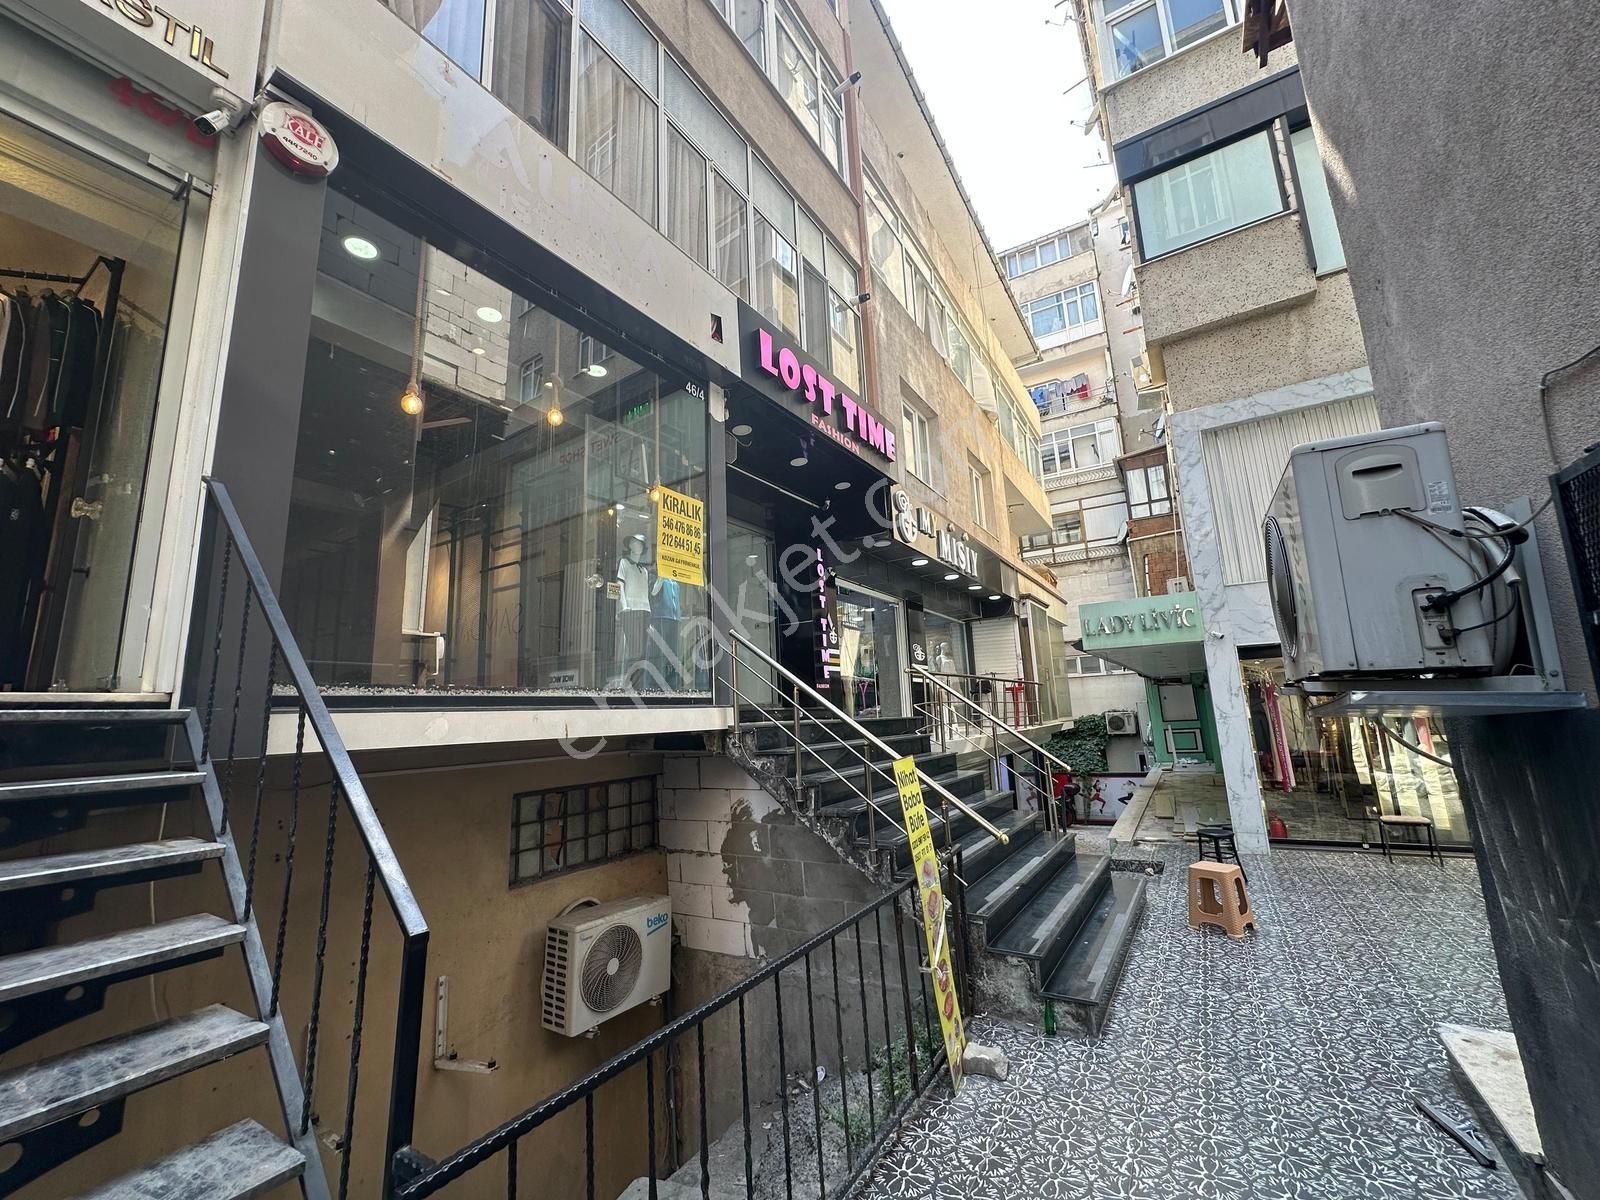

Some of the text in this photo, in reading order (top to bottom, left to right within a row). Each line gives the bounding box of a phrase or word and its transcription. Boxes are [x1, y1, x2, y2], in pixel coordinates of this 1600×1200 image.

[99, 0, 230, 80] STİL
[283, 111, 326, 150] KALE
[282, 136, 318, 161] 4447240
[685, 381, 705, 401] 46/4
[757, 327, 896, 463] LOST TIME
[811, 412, 860, 456] FASHION
[662, 515, 674, 531] 546
[674, 519, 686, 535] 476
[685, 523, 694, 537] 86
[917, 506, 938, 538] MY
[661, 531, 701, 555] 212 644 51 45
[816, 547, 830, 679] LOST TIME
[1083, 614, 1136, 637] LADY
[896, 767, 917, 789] Nihat
[902, 791, 922, 812] Baba
[908, 811, 925, 834] Büfe
[646, 912, 669, 929] beko
